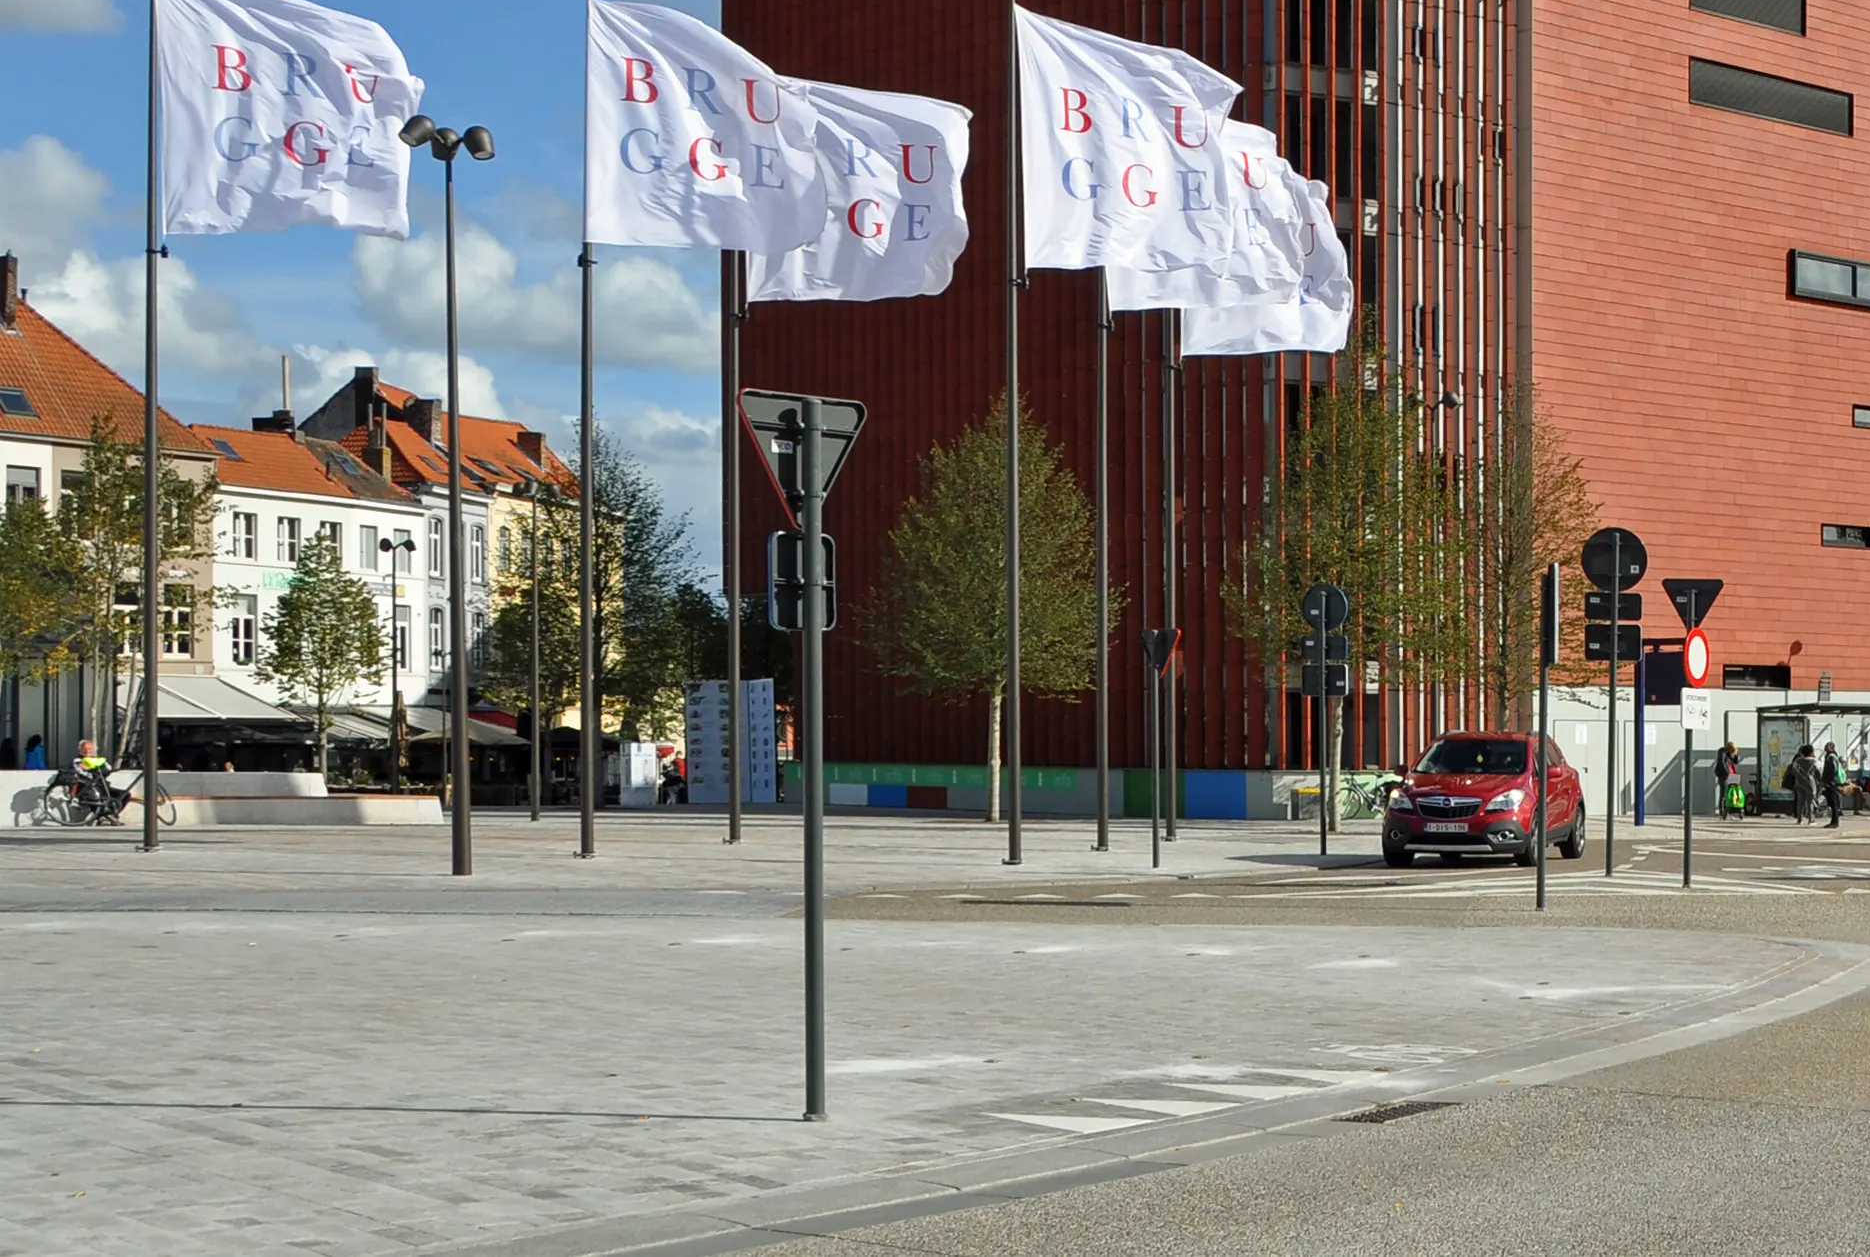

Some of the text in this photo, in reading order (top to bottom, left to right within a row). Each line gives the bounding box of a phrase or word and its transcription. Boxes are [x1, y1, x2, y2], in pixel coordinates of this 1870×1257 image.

[620, 56, 780, 124] BRU
[1060, 87, 1208, 149] BRU
[619, 127, 785, 190] GGE
[843, 138, 938, 184] RU
[1061, 156, 1212, 212] GGE
[846, 197, 933, 242] GE
